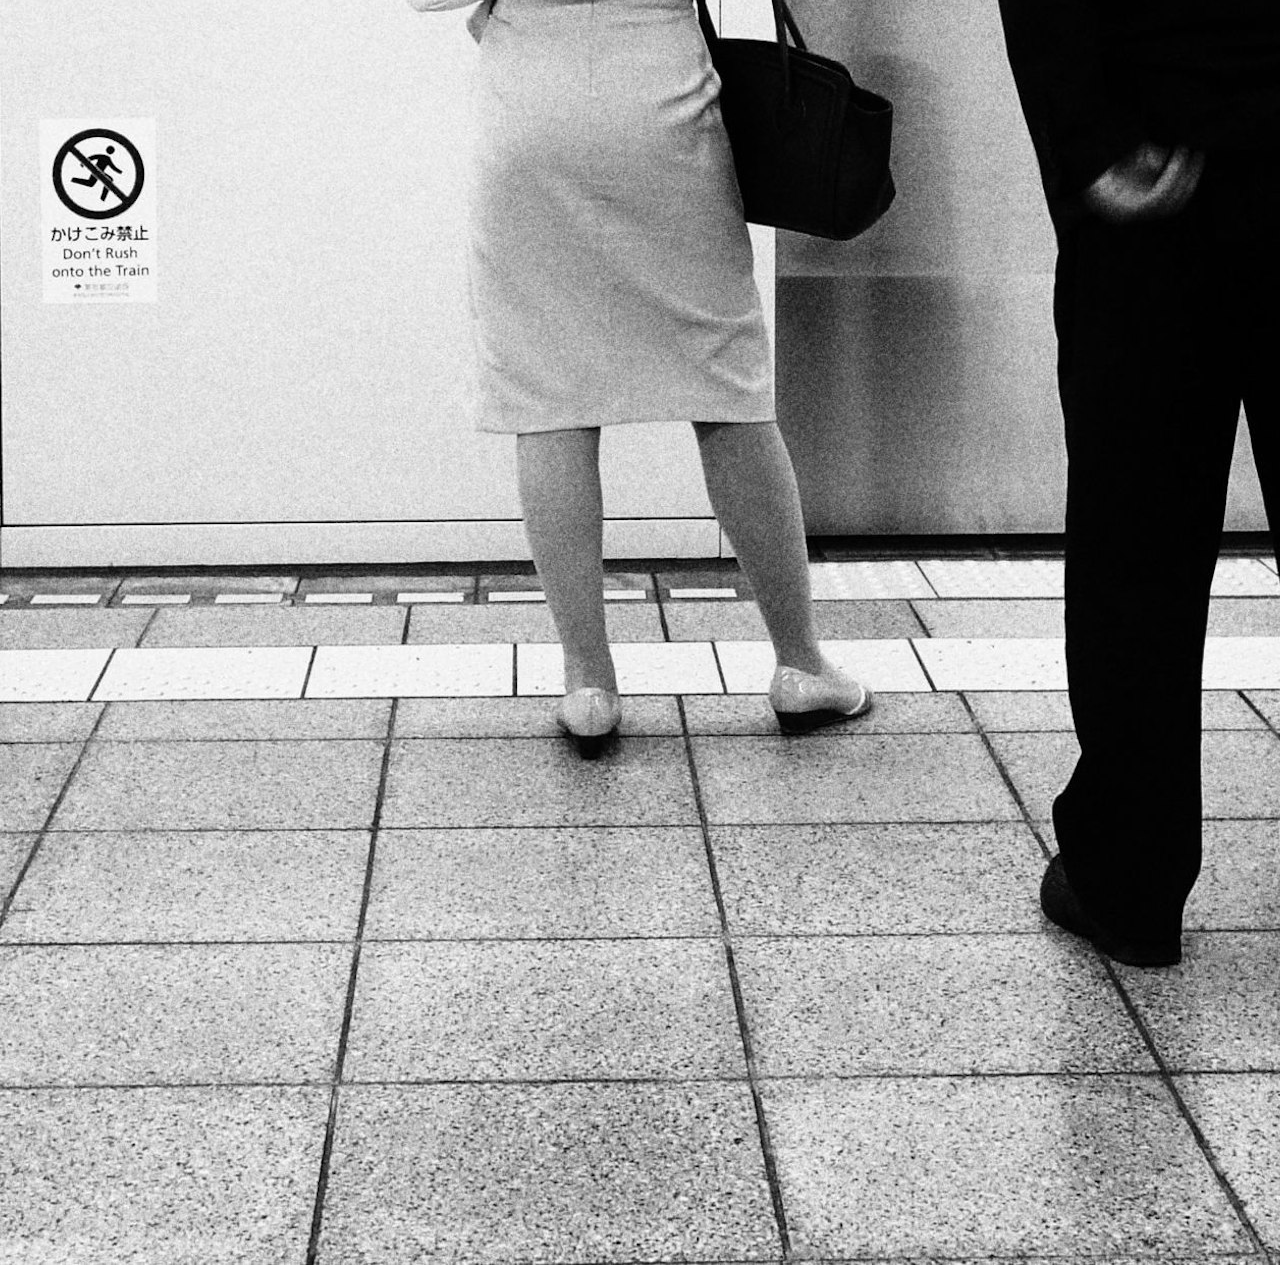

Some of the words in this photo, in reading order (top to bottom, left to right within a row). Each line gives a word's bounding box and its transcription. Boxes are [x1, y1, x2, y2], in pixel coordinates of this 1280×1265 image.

[51, 224, 149, 242] かけこみ禁止
[63, 247, 101, 260] Don't
[105, 246, 138, 259] Rush
[52, 267, 84, 278] onto
[89, 265, 111, 277] the
[115, 264, 150, 277] Train
